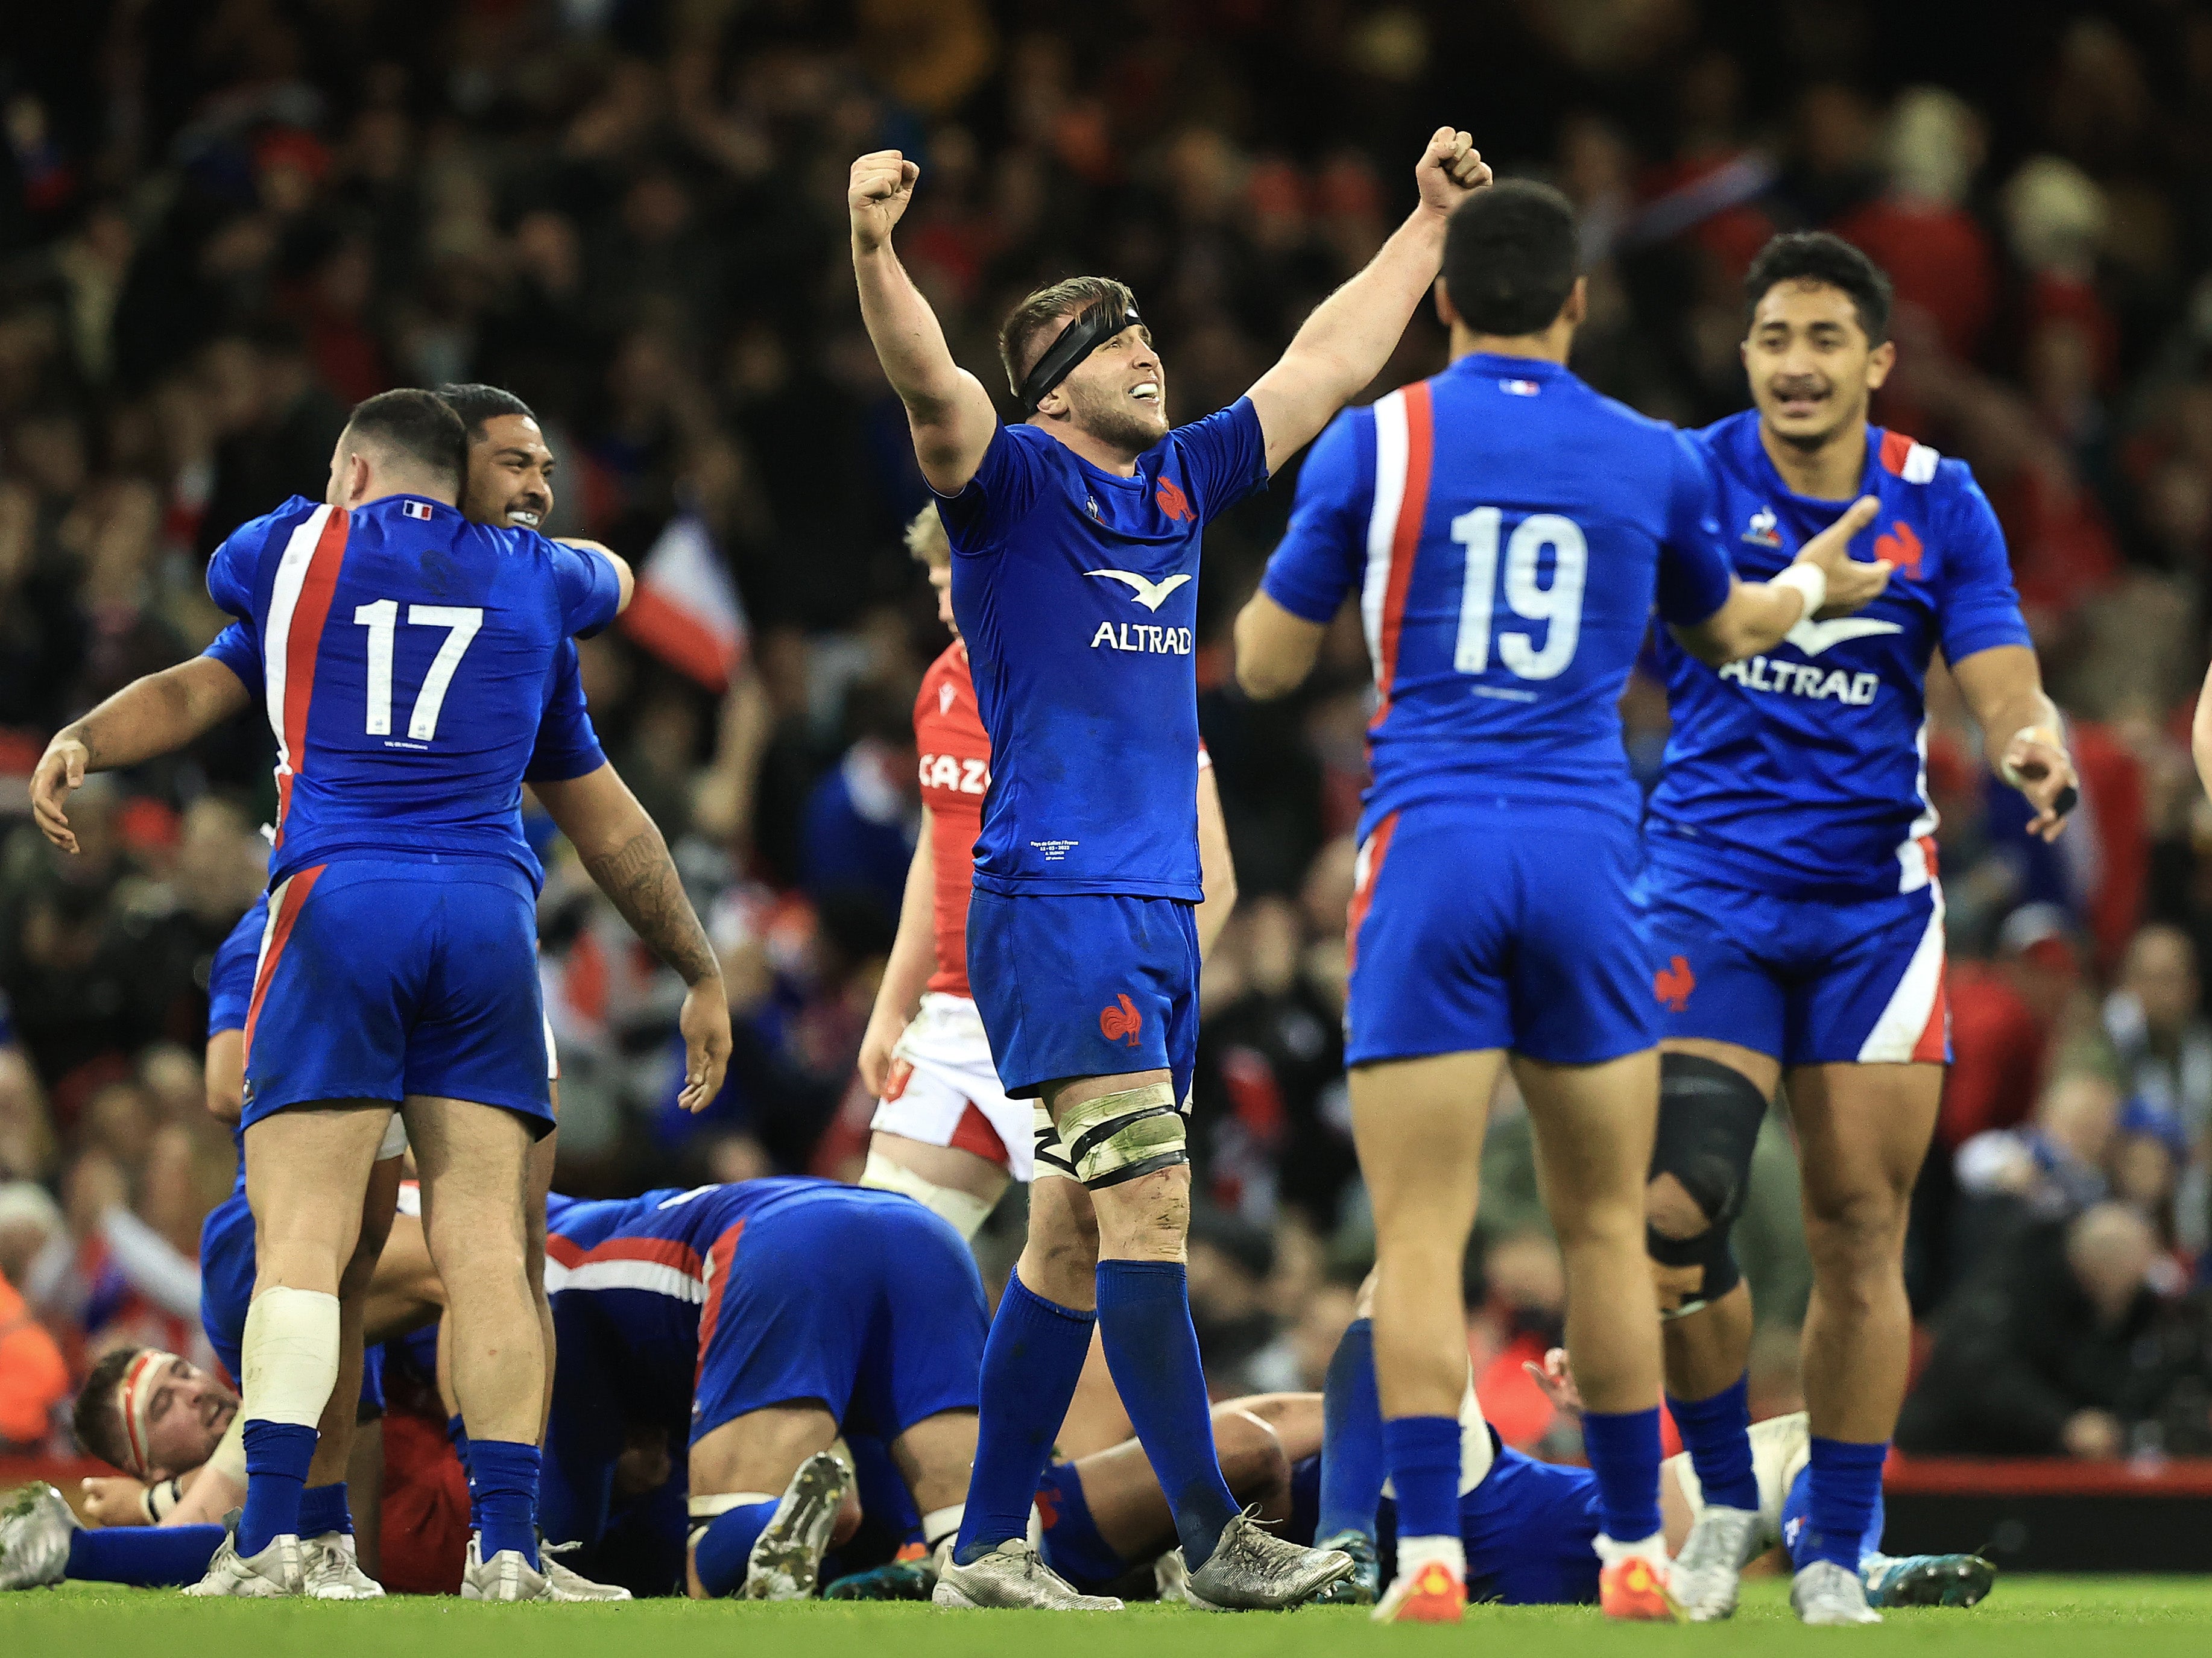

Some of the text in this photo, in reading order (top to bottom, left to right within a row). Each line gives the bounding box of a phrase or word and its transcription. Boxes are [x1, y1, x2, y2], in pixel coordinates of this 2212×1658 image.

[1450, 506, 1588, 681] 19
[1090, 622, 1192, 655] ALTRAD
[353, 599, 484, 742] 17
[1719, 655, 1880, 705] ALTRAD
[918, 753, 992, 795] CAZ
